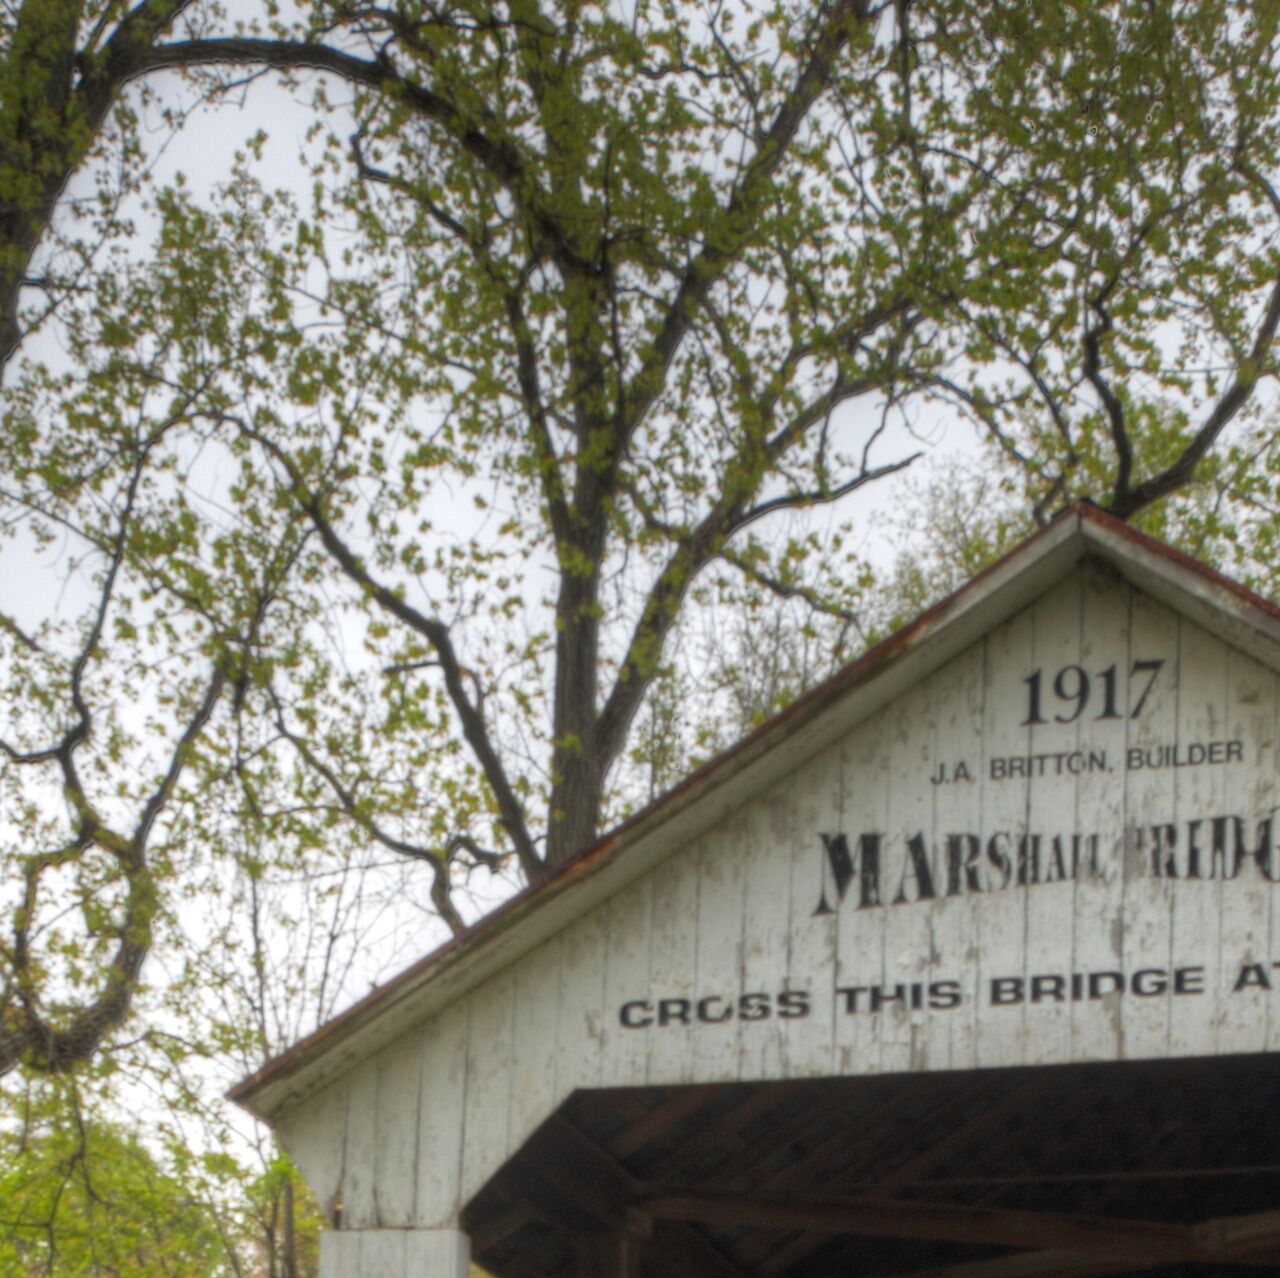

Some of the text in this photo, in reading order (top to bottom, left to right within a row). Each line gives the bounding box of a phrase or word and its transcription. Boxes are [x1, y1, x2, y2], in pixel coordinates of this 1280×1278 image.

[1020, 657, 1167, 727] 1917
[1126, 739, 1245, 771] BUILDER
[618, 990, 811, 1030] CROSS
[835, 979, 963, 1016] THIS
[989, 965, 1205, 1007] BRIDGE
